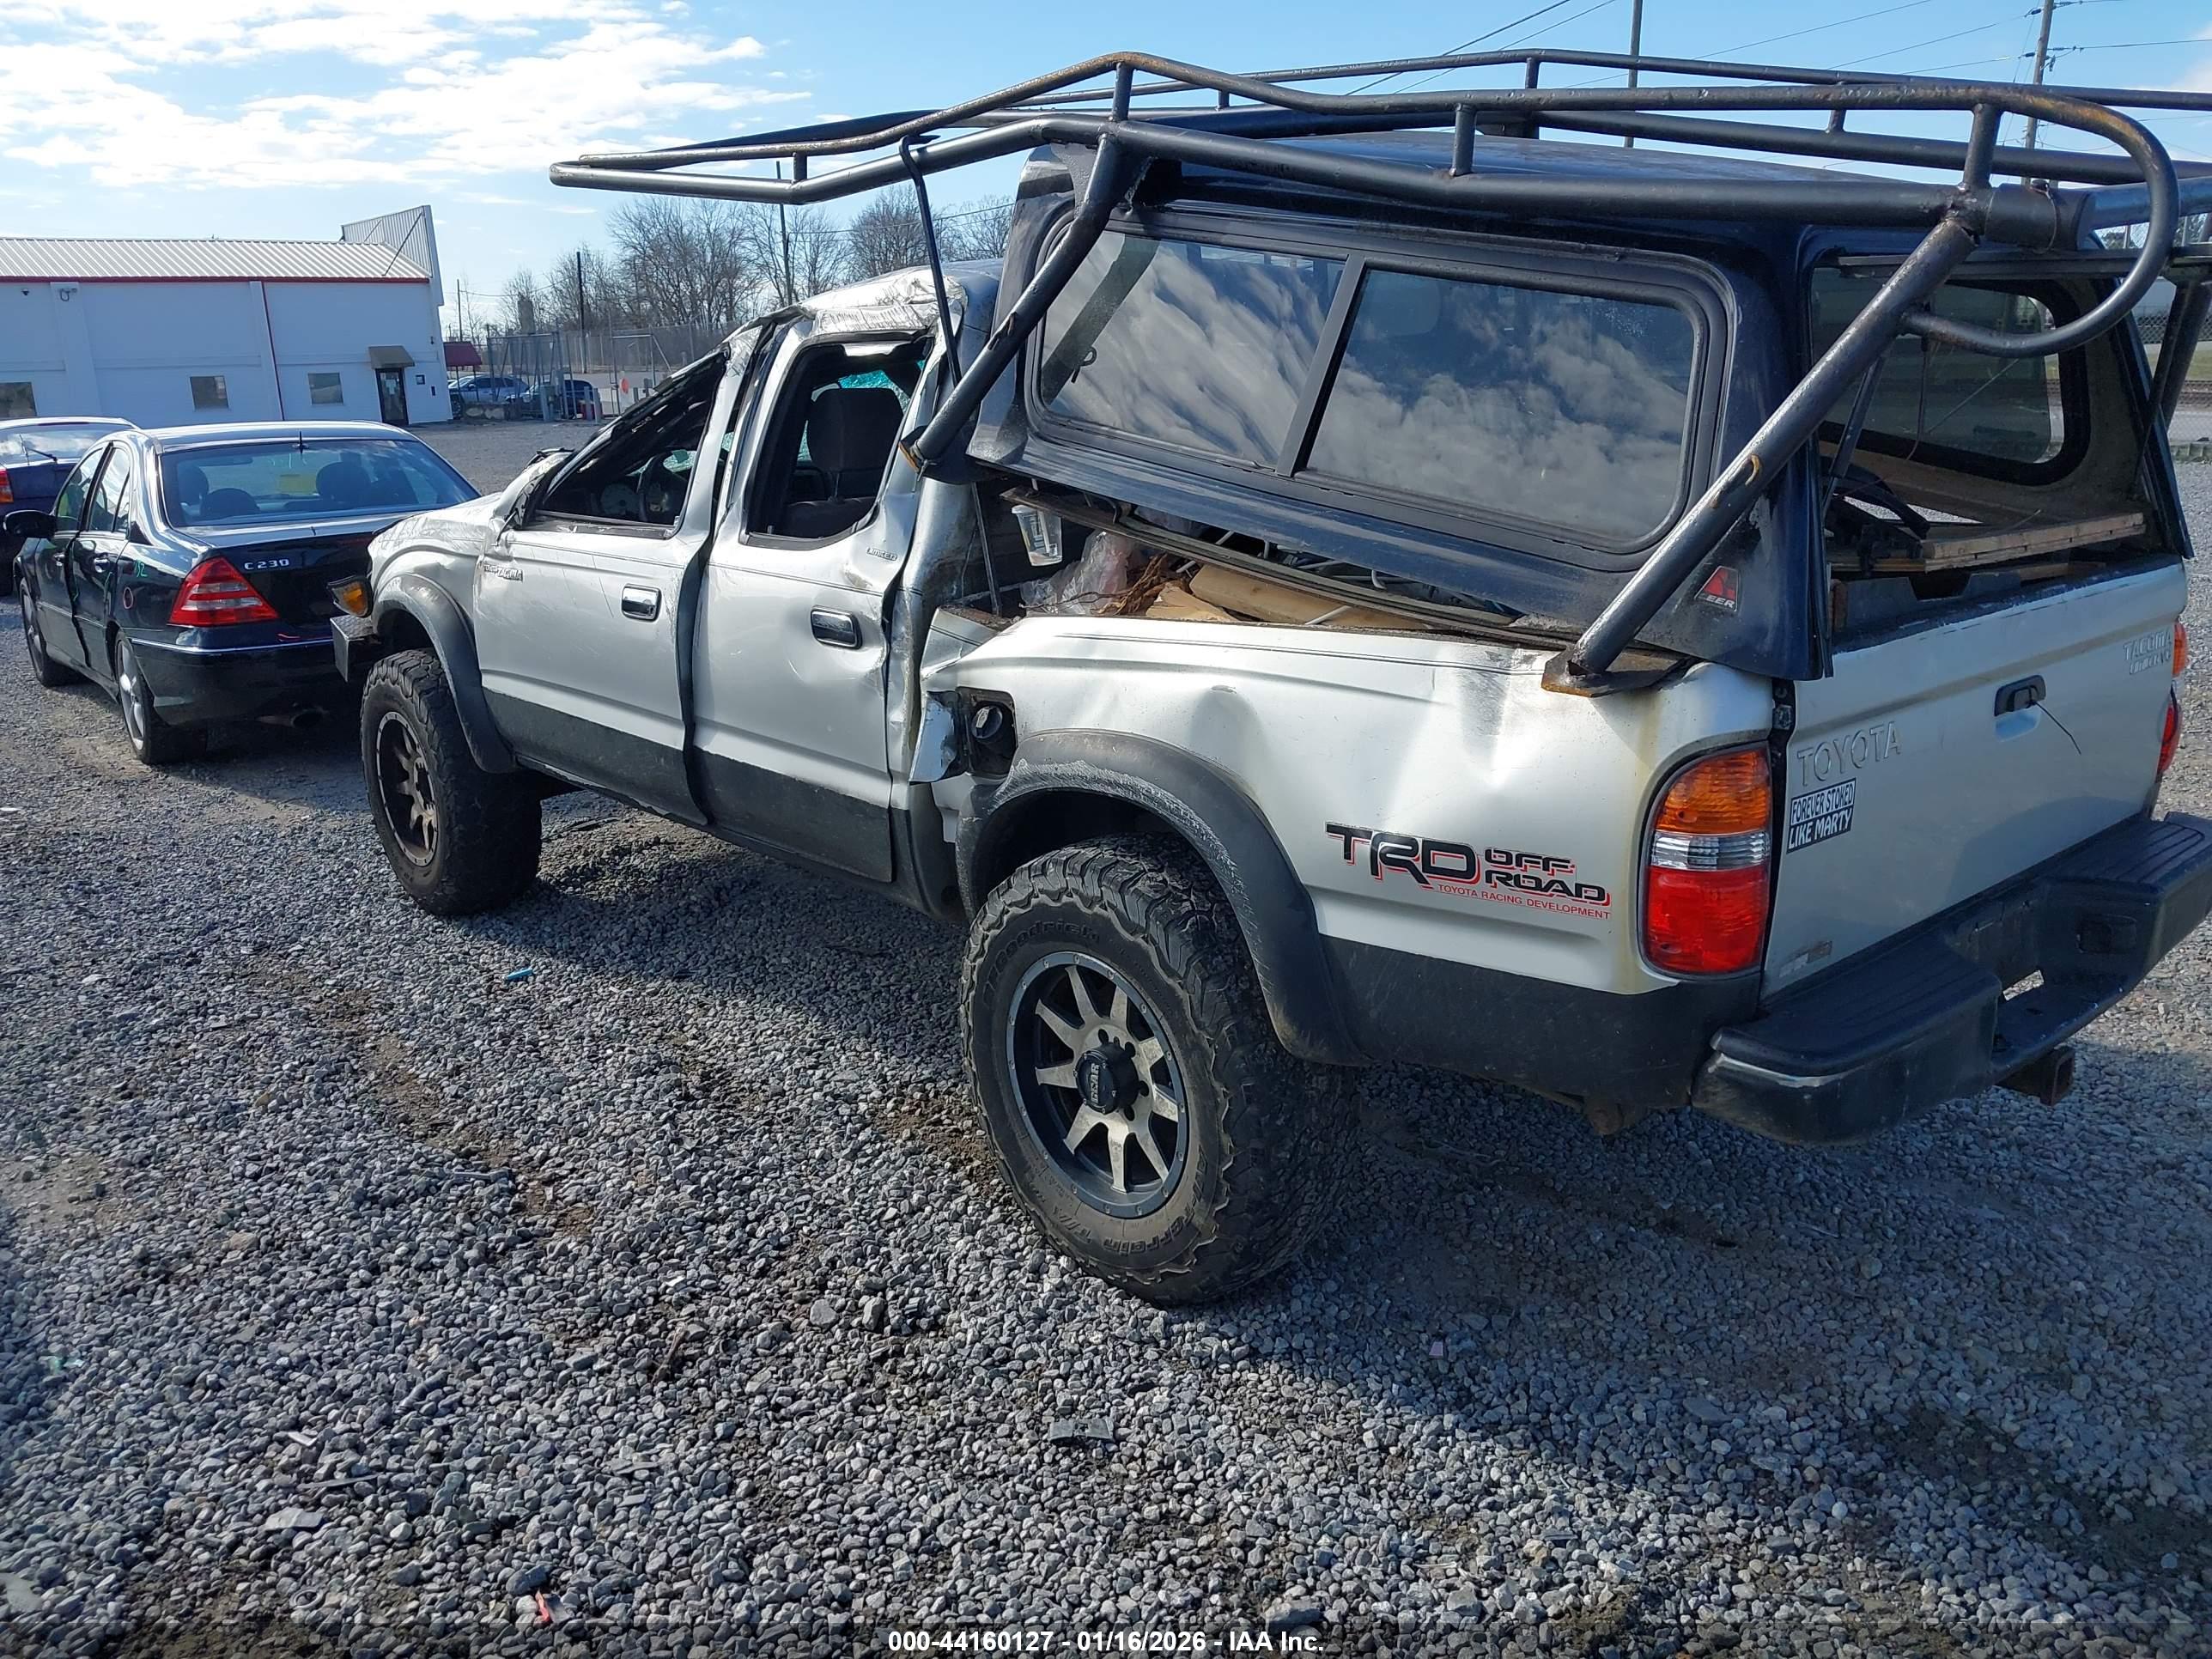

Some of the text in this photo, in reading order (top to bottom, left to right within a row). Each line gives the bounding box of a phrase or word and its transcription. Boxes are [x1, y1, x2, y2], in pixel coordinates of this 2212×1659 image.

[1796, 720, 1900, 787] TOYOTA
[1791, 782, 1854, 824] FOREVER STOKED
[1788, 807, 1853, 849] LIKE MARTY
[1325, 822, 1481, 890] TRD
[1484, 848, 1575, 876] OFF
[1437, 883, 1611, 921] TOYOTA RACING DEVELOPMENT
[1484, 869, 1610, 907] ROAD
